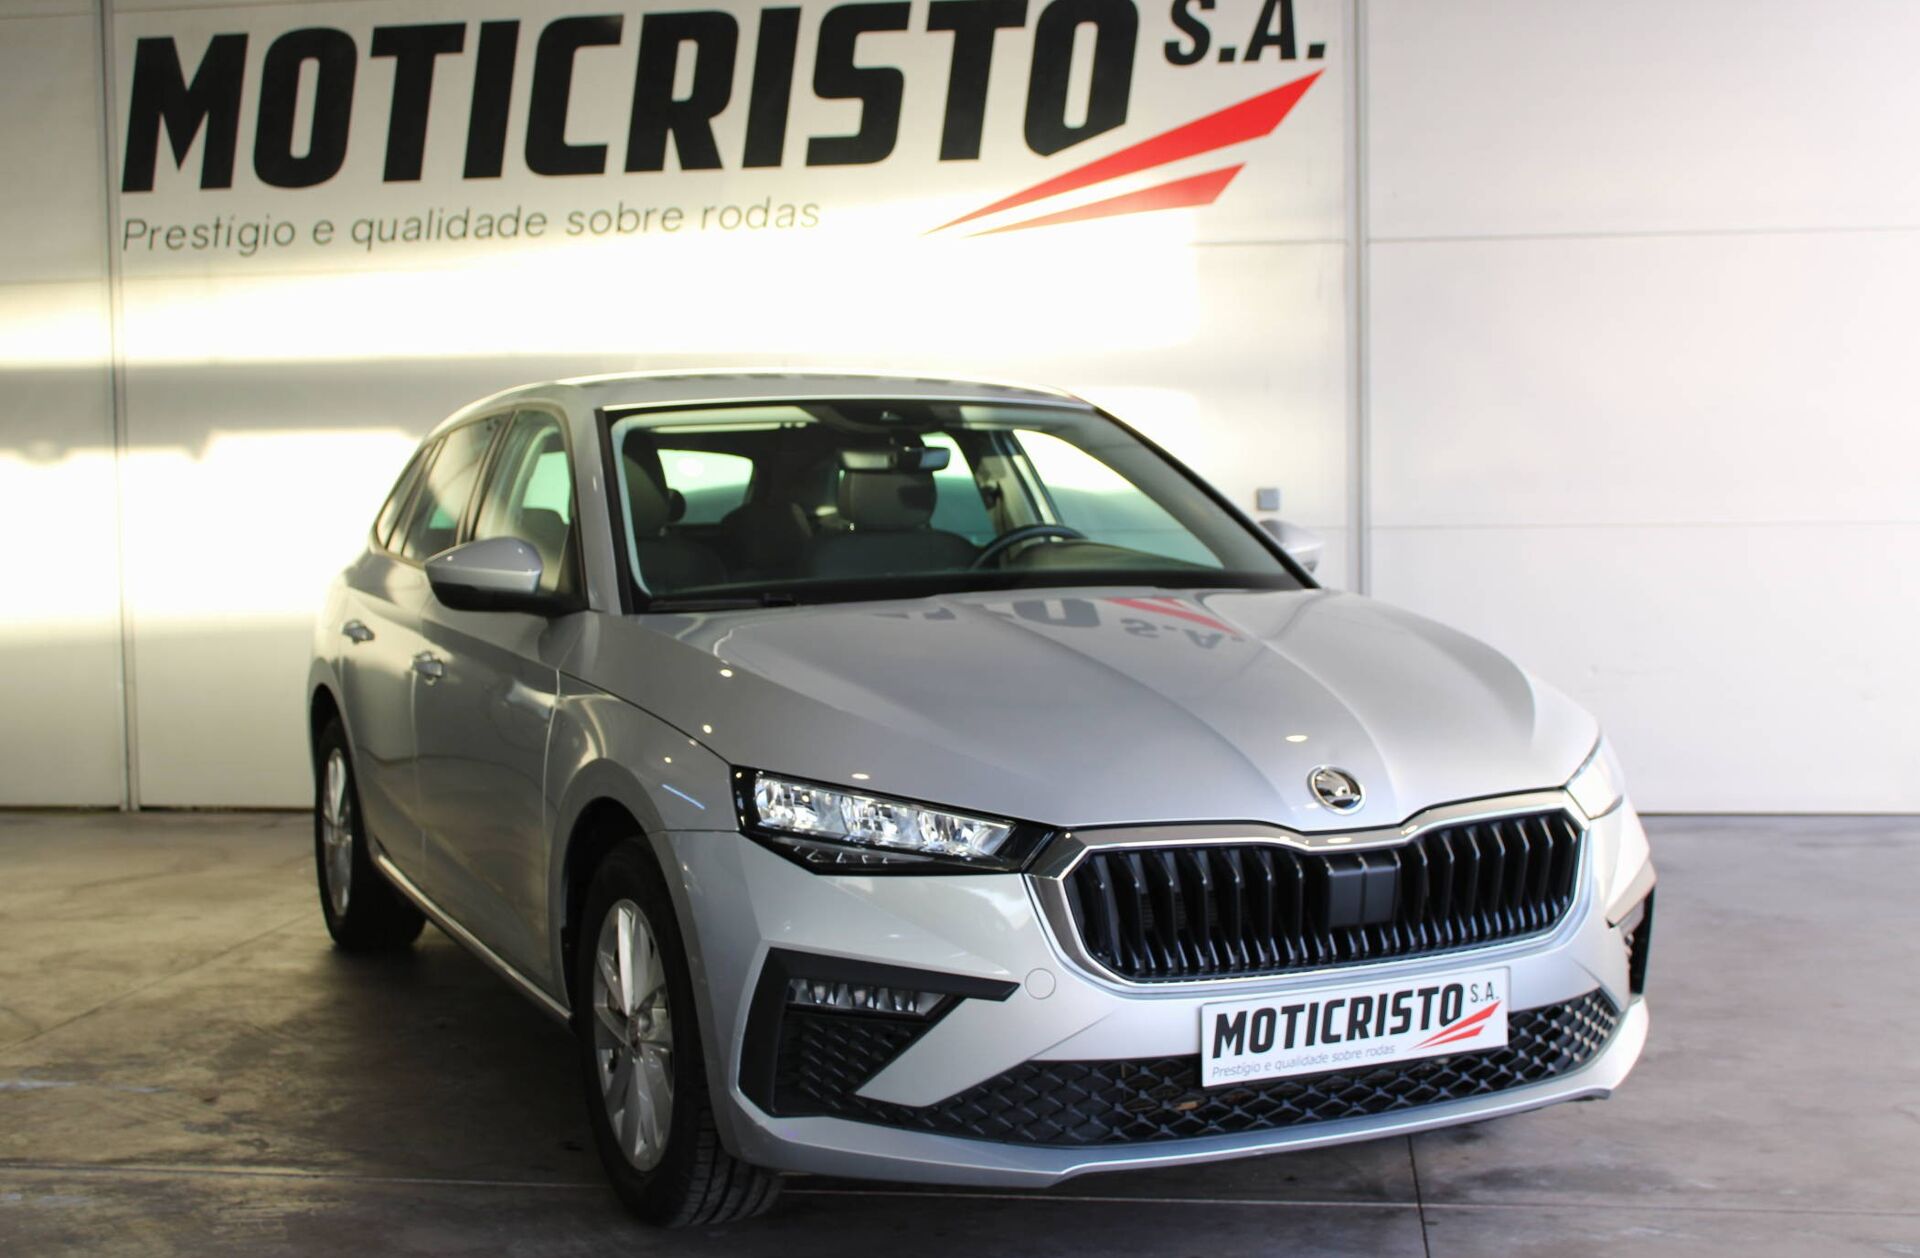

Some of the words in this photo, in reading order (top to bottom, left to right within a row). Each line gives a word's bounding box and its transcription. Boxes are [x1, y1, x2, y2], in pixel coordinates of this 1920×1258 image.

[122, 0, 1139, 193] MOTICRISTO
[1164, 0, 1326, 66] S.A.
[312, 218, 335, 245] e
[351, 205, 548, 253] qualidade
[565, 201, 684, 236] sobre
[701, 195, 820, 231] rodas
[1212, 983, 1463, 1058] MOTICRISTO
[1470, 981, 1500, 1003] S.A.
[1274, 1052, 1329, 1071] qualidade
[1331, 1047, 1362, 1063] sobre
[1365, 1044, 1396, 1058] rodas
